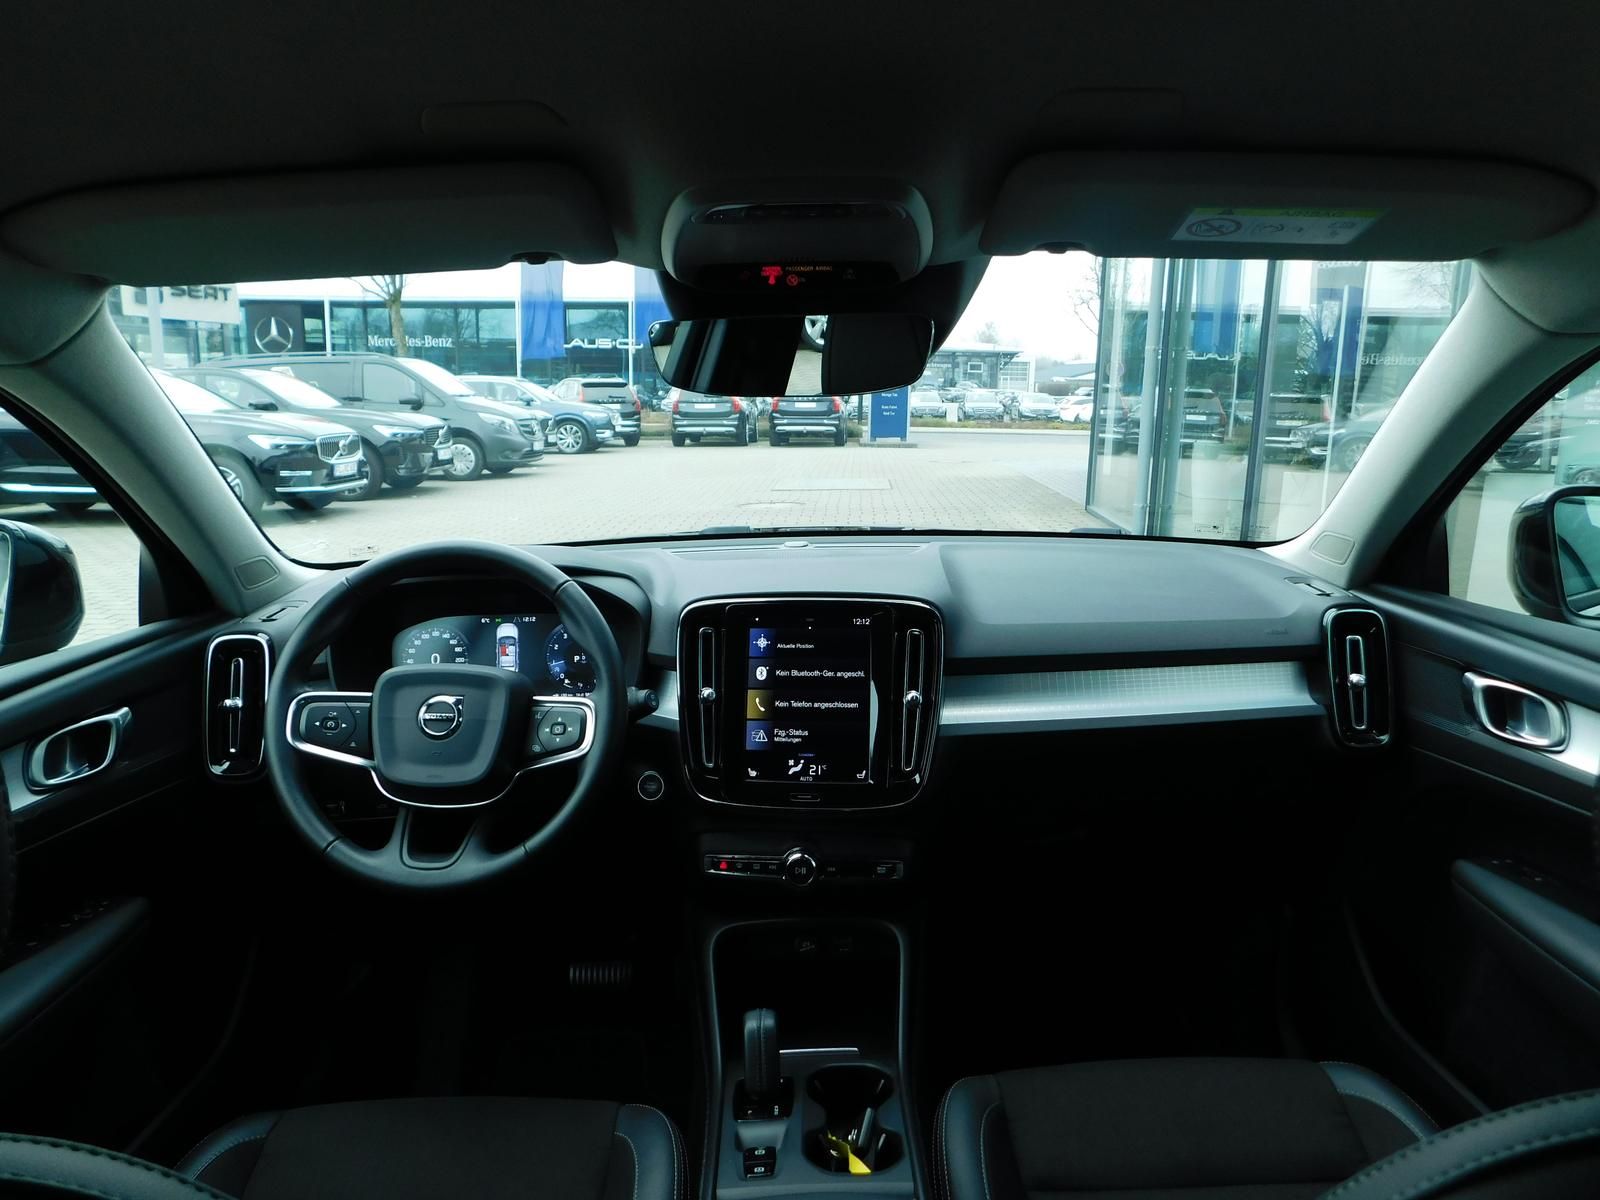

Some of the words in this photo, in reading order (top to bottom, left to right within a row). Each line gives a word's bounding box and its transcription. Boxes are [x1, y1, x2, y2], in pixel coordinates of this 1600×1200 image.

[170, 285, 232, 302] SEAT
[367, 334, 453, 348] Merces-Benz
[431, 653, 440, 665] 0
[574, 655, 580, 663] P
[775, 669, 790, 677] Kein
[791, 669, 835, 677] Bluetooth-Ger.
[836, 670, 865, 679] angeschl.
[790, 700, 812, 708] Telefon
[813, 701, 859, 709] angeschlossen
[774, 728, 809, 737] Fzg.-Status
